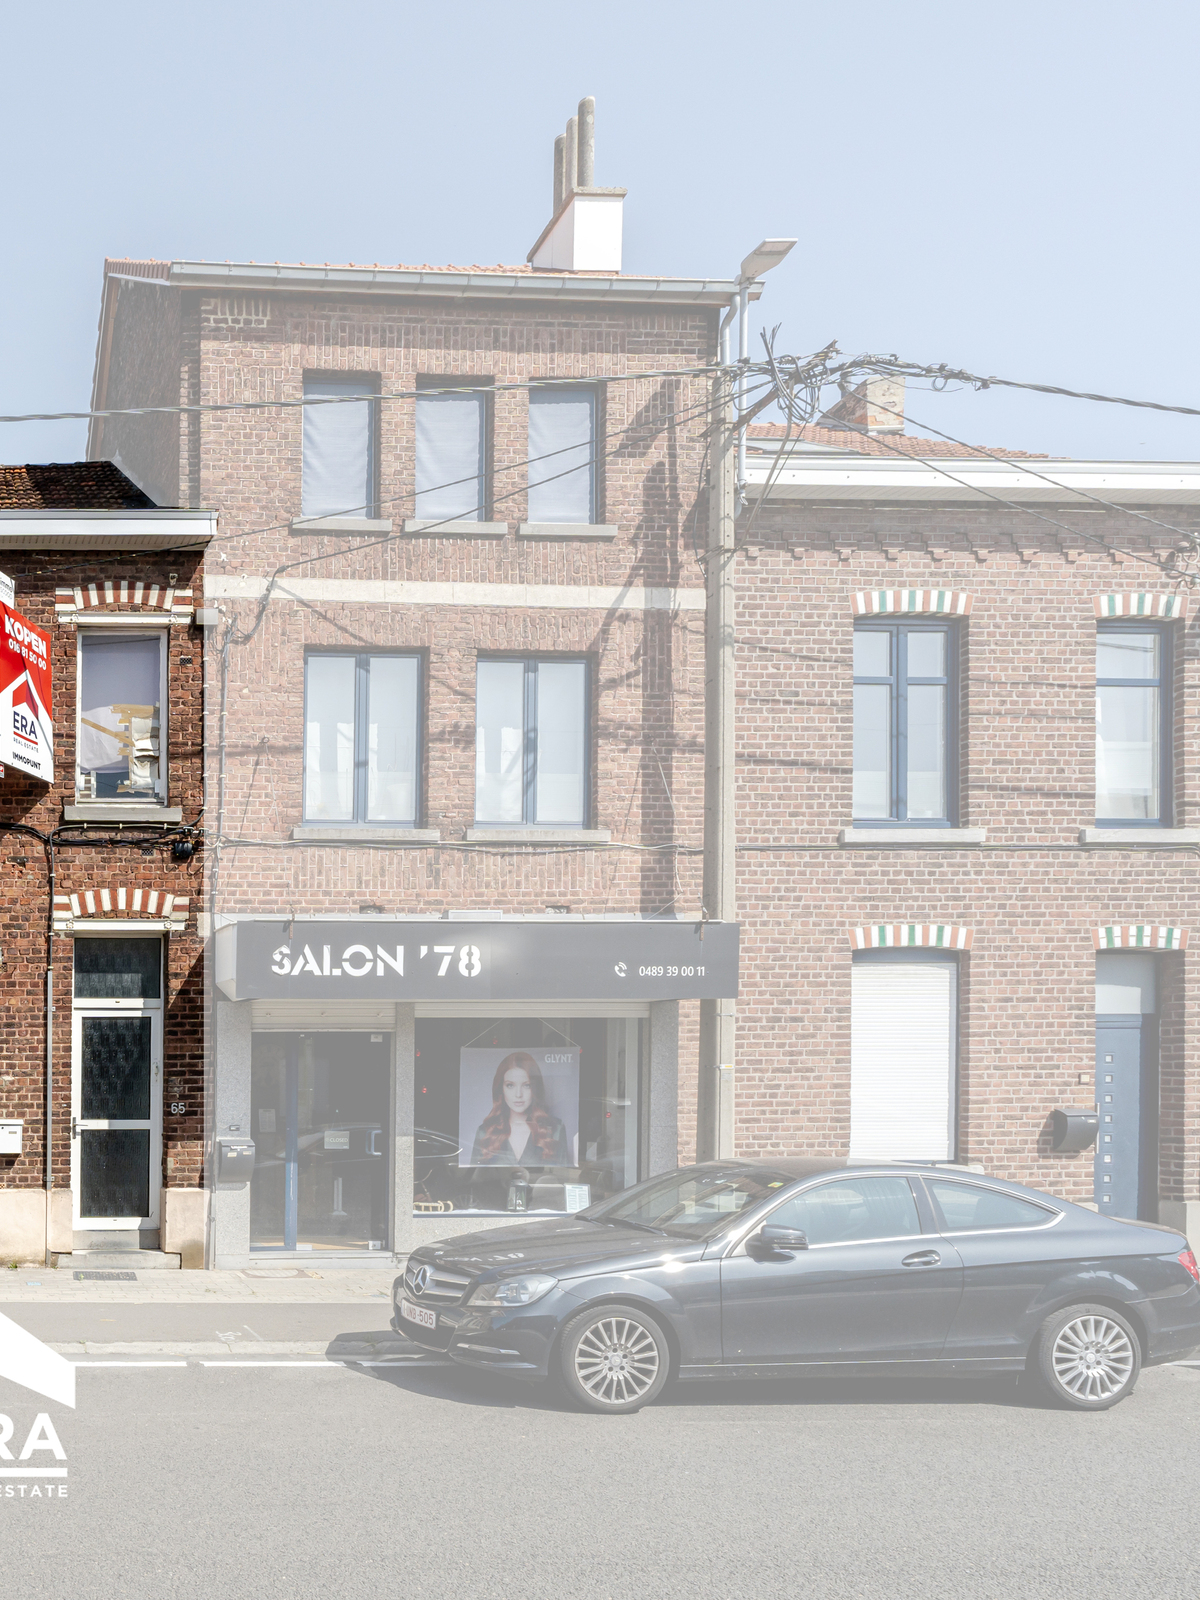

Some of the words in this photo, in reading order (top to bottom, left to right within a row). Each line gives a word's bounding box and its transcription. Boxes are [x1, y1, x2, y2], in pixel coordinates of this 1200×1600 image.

[4, 614, 47, 659] KOPEN
[8, 638, 21, 654] 016
[21, 646, 29, 659] 81
[28, 653, 38, 665] 50
[37, 657, 47, 671] 00
[13, 710, 38, 740] ERA
[13, 737, 24, 746] REAL
[12, 751, 41, 770] IMMOPUNT
[271, 944, 405, 977] SALON
[419, 944, 482, 977] '78
[638, 966, 664, 977] 0489
[666, 966, 679, 977] 39
[681, 966, 694, 977] 00
[696, 966, 705, 977] 11
[544, 1053, 573, 1063] GLYNT
[170, 1102, 186, 1114] 65
